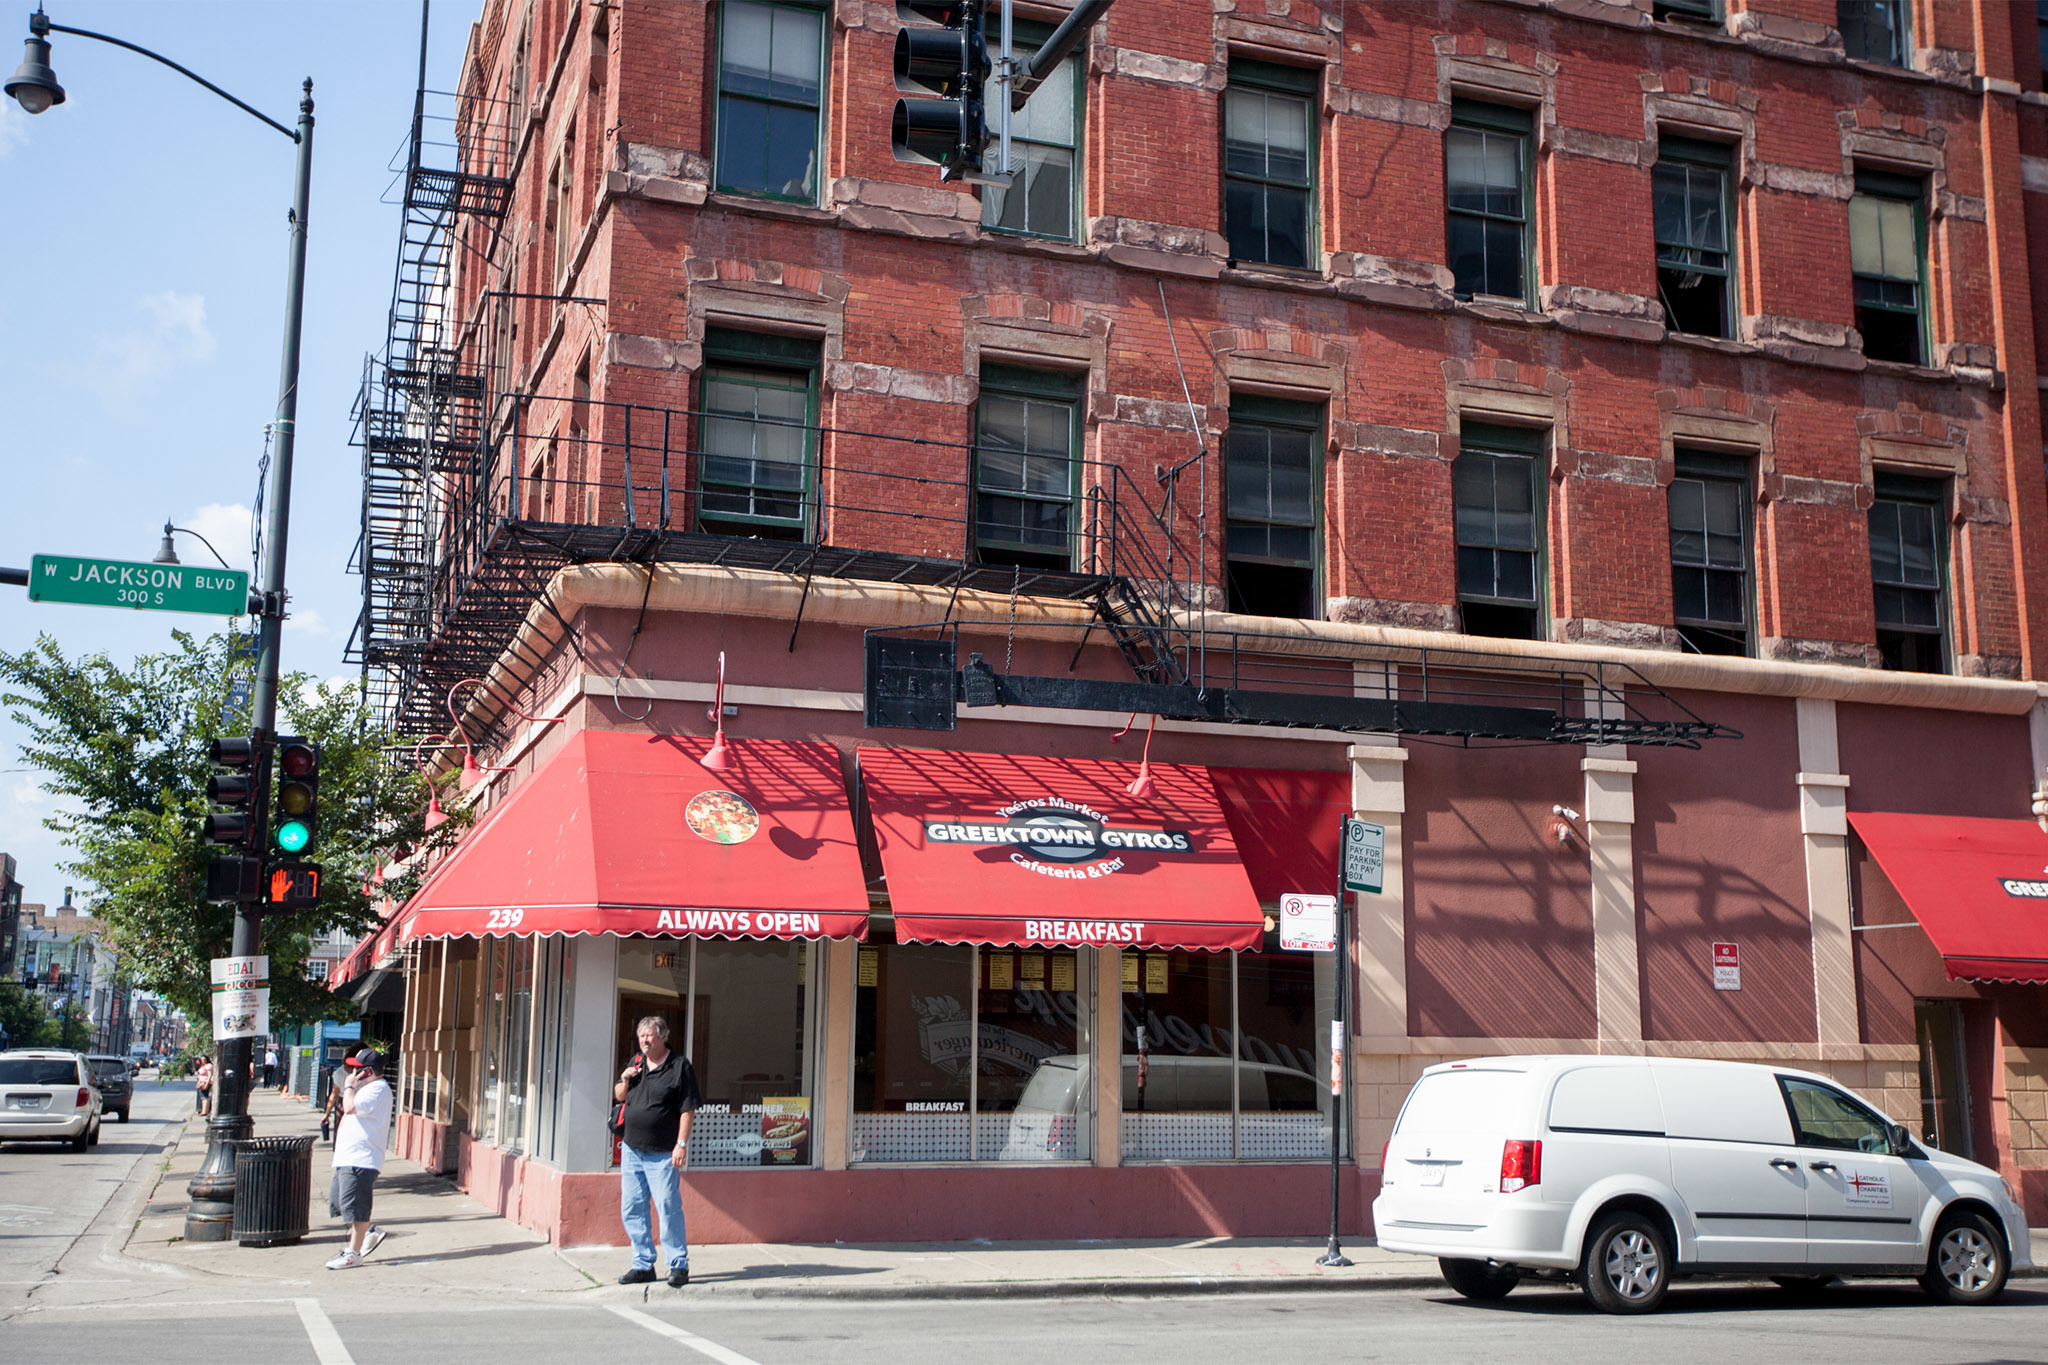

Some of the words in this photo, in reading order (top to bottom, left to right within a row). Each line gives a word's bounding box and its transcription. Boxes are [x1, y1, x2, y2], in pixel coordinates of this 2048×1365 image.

[45, 564, 57, 577] W
[69, 563, 182, 589] JACKSON
[195, 576, 235, 591] BLVD
[117, 589, 149, 603] 300
[154, 592, 164, 605] S
[1049, 796, 1110, 825] Market
[927, 824, 1096, 846] GREEKTOWN
[1101, 830, 1189, 850] GYROS
[1349, 845, 1364, 854] PAY
[1366, 848, 1380, 858] FOR
[1009, 852, 1087, 879] Cafeteria
[1087, 865, 1103, 878] &
[1098, 857, 1125, 875] Bar
[1349, 854, 1381, 867] PARKING
[1348, 871, 1364, 880] BOX
[1349, 863, 1359, 871] AT
[1360, 865, 1375, 874] PAY
[307, 870, 318, 898] 7
[486, 908, 524, 929] 239
[656, 909, 751, 931] ALWAYS
[755, 913, 820, 932] OPEN
[1025, 920, 1145, 942] BREAKFAST
[654, 953, 676, 968] EXIT
[224, 980, 256, 992] GUCCI
[742, 1103, 784, 1114] DINNER
[905, 1101, 965, 1112] BREAKFAST
